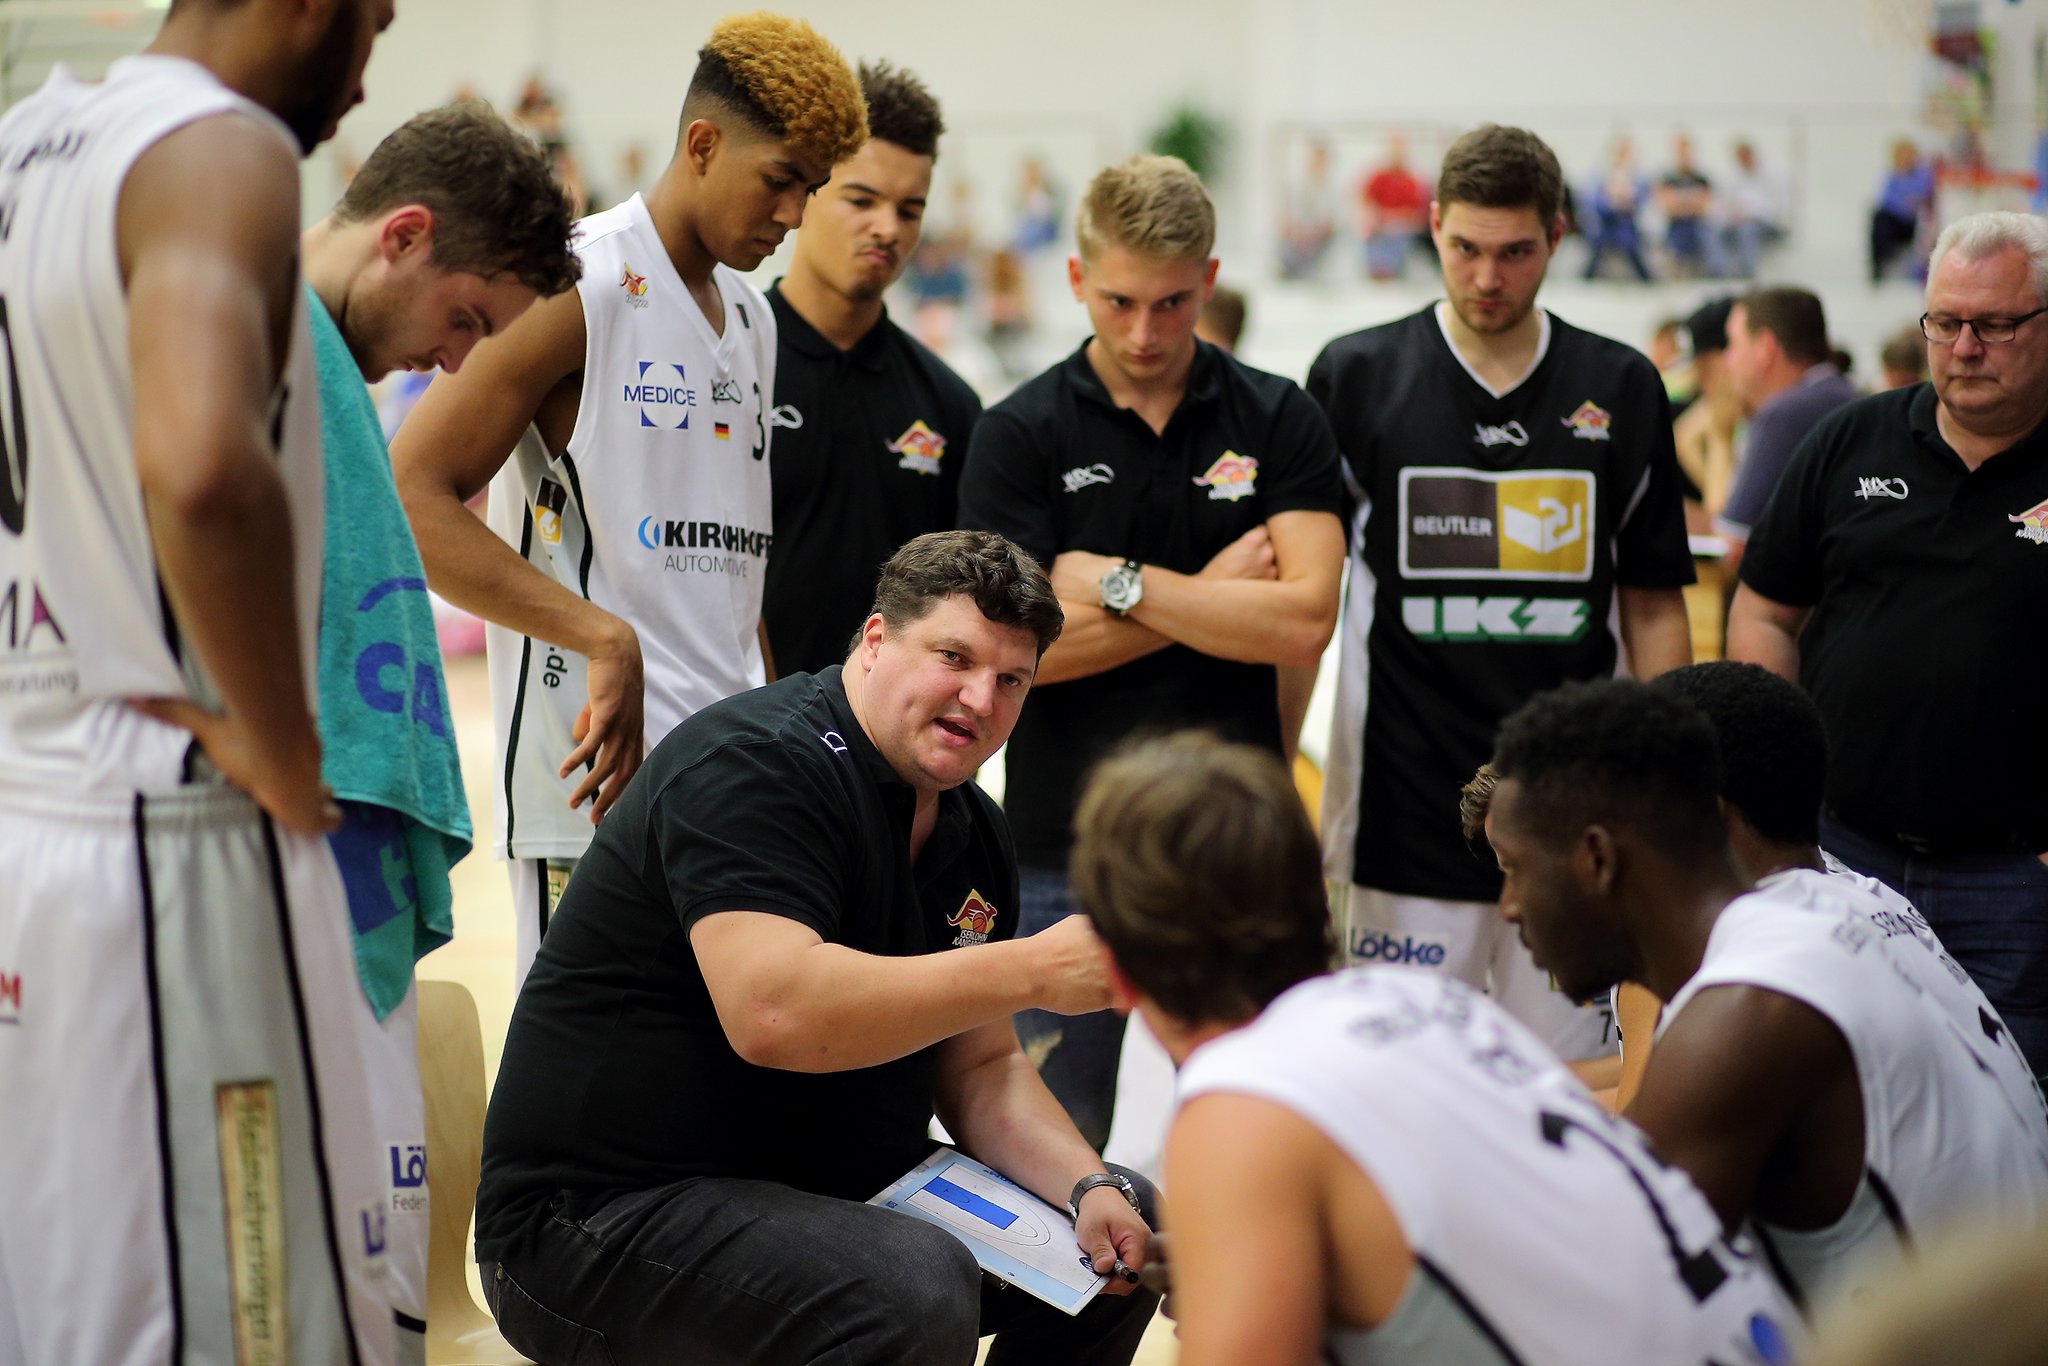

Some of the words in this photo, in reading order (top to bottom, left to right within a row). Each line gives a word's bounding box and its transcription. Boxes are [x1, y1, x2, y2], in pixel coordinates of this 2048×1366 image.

[624, 385, 697, 407] MEDICE
[1413, 515, 1493, 536] BEUTLER
[1350, 927, 1446, 966] Löbke
